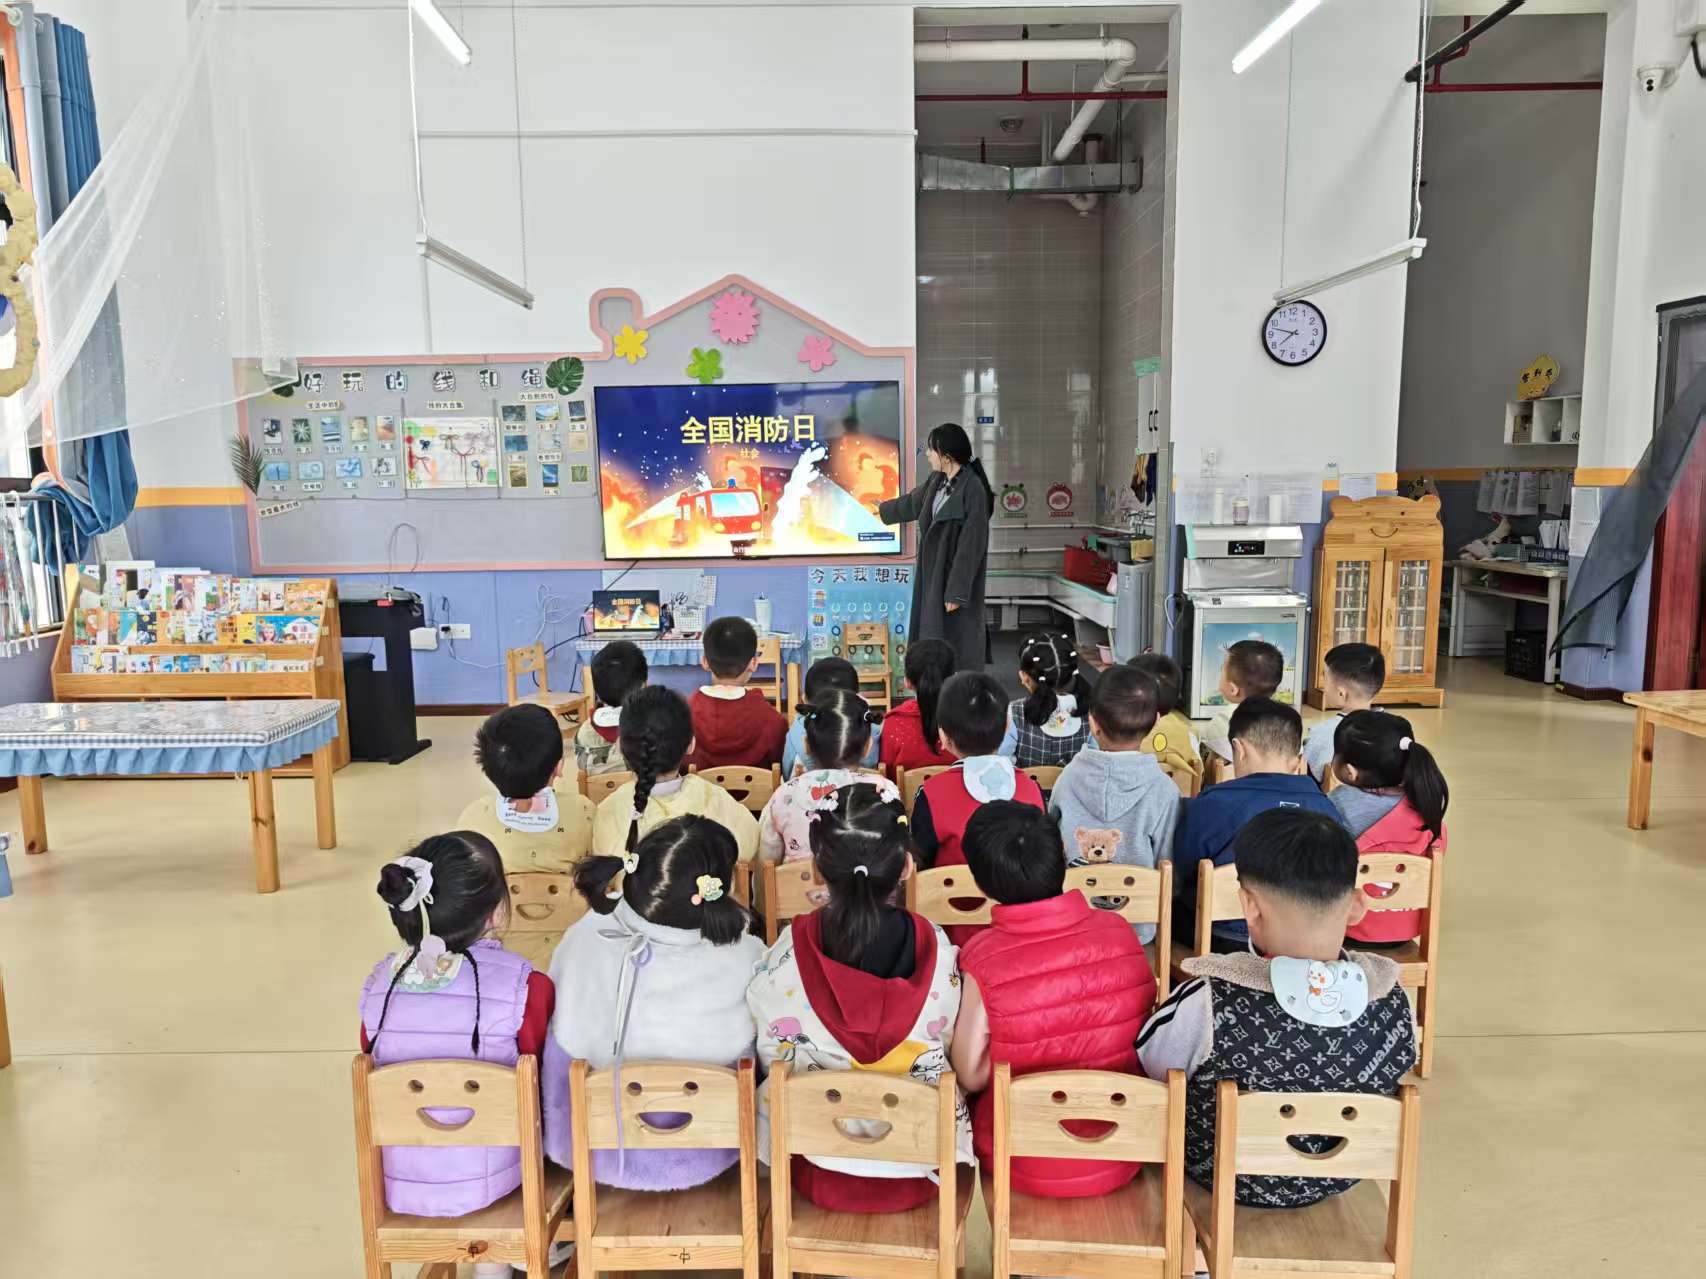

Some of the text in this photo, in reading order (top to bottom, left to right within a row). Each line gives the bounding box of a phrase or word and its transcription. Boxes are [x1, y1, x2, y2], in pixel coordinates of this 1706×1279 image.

[304, 369, 543, 392] 好玩的线和绳
[680, 414, 815, 444] 全国消防日
[811, 568, 910, 584] 今天我想玩
